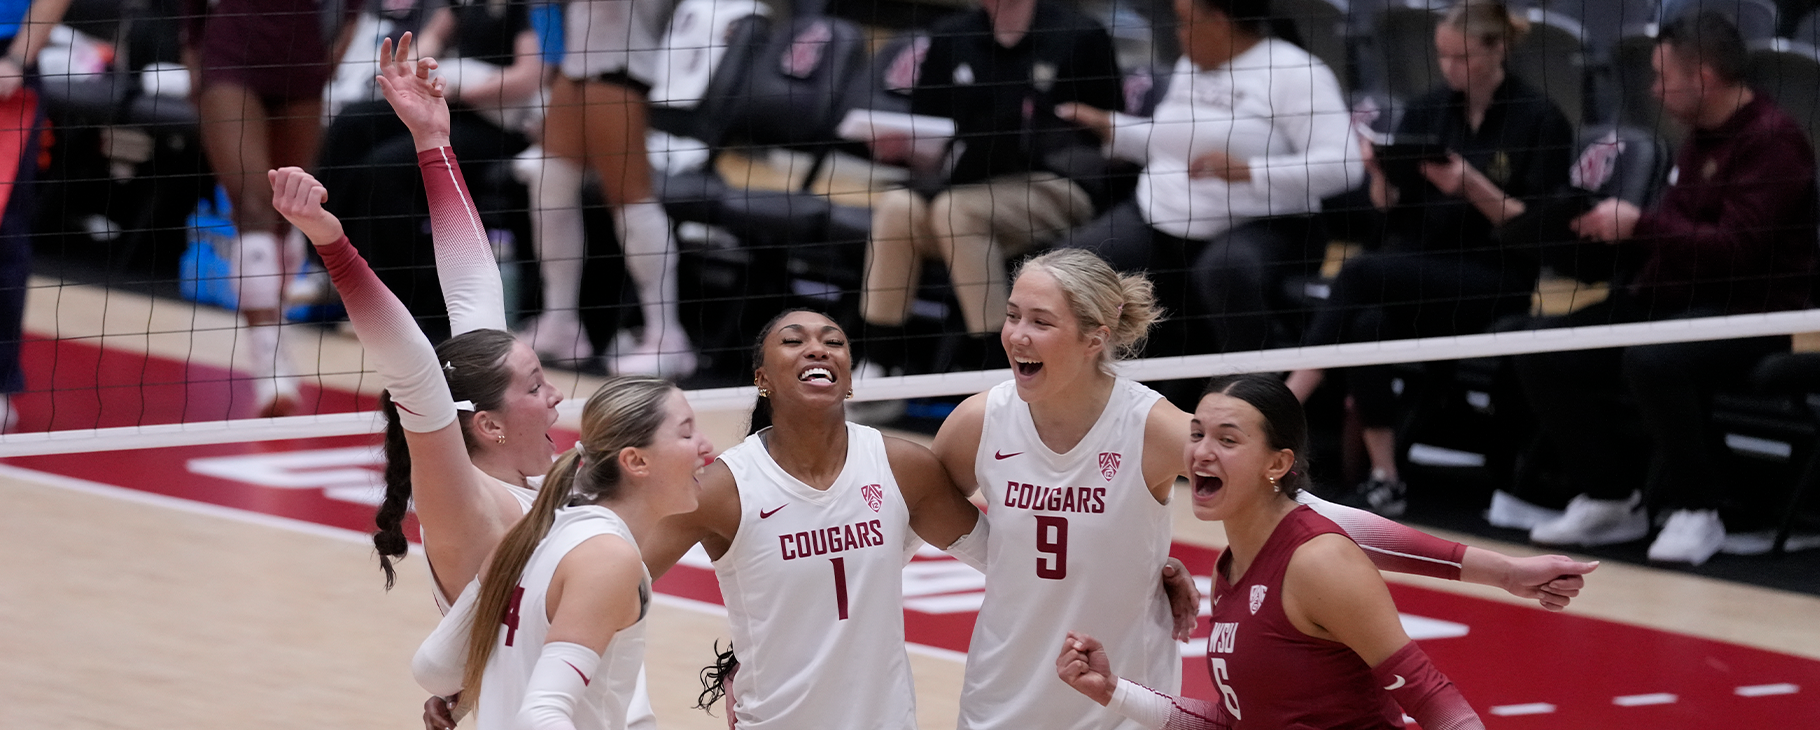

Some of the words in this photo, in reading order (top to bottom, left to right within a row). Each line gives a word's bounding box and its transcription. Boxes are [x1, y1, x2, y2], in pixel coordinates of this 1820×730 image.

[1004, 480, 1106, 514] COUGARS
[778, 519, 884, 560] COUGARS
[1033, 515, 1068, 580] 9
[829, 557, 849, 620] 1
[1208, 622, 1239, 653] WSU
[1211, 657, 1242, 720] 6
